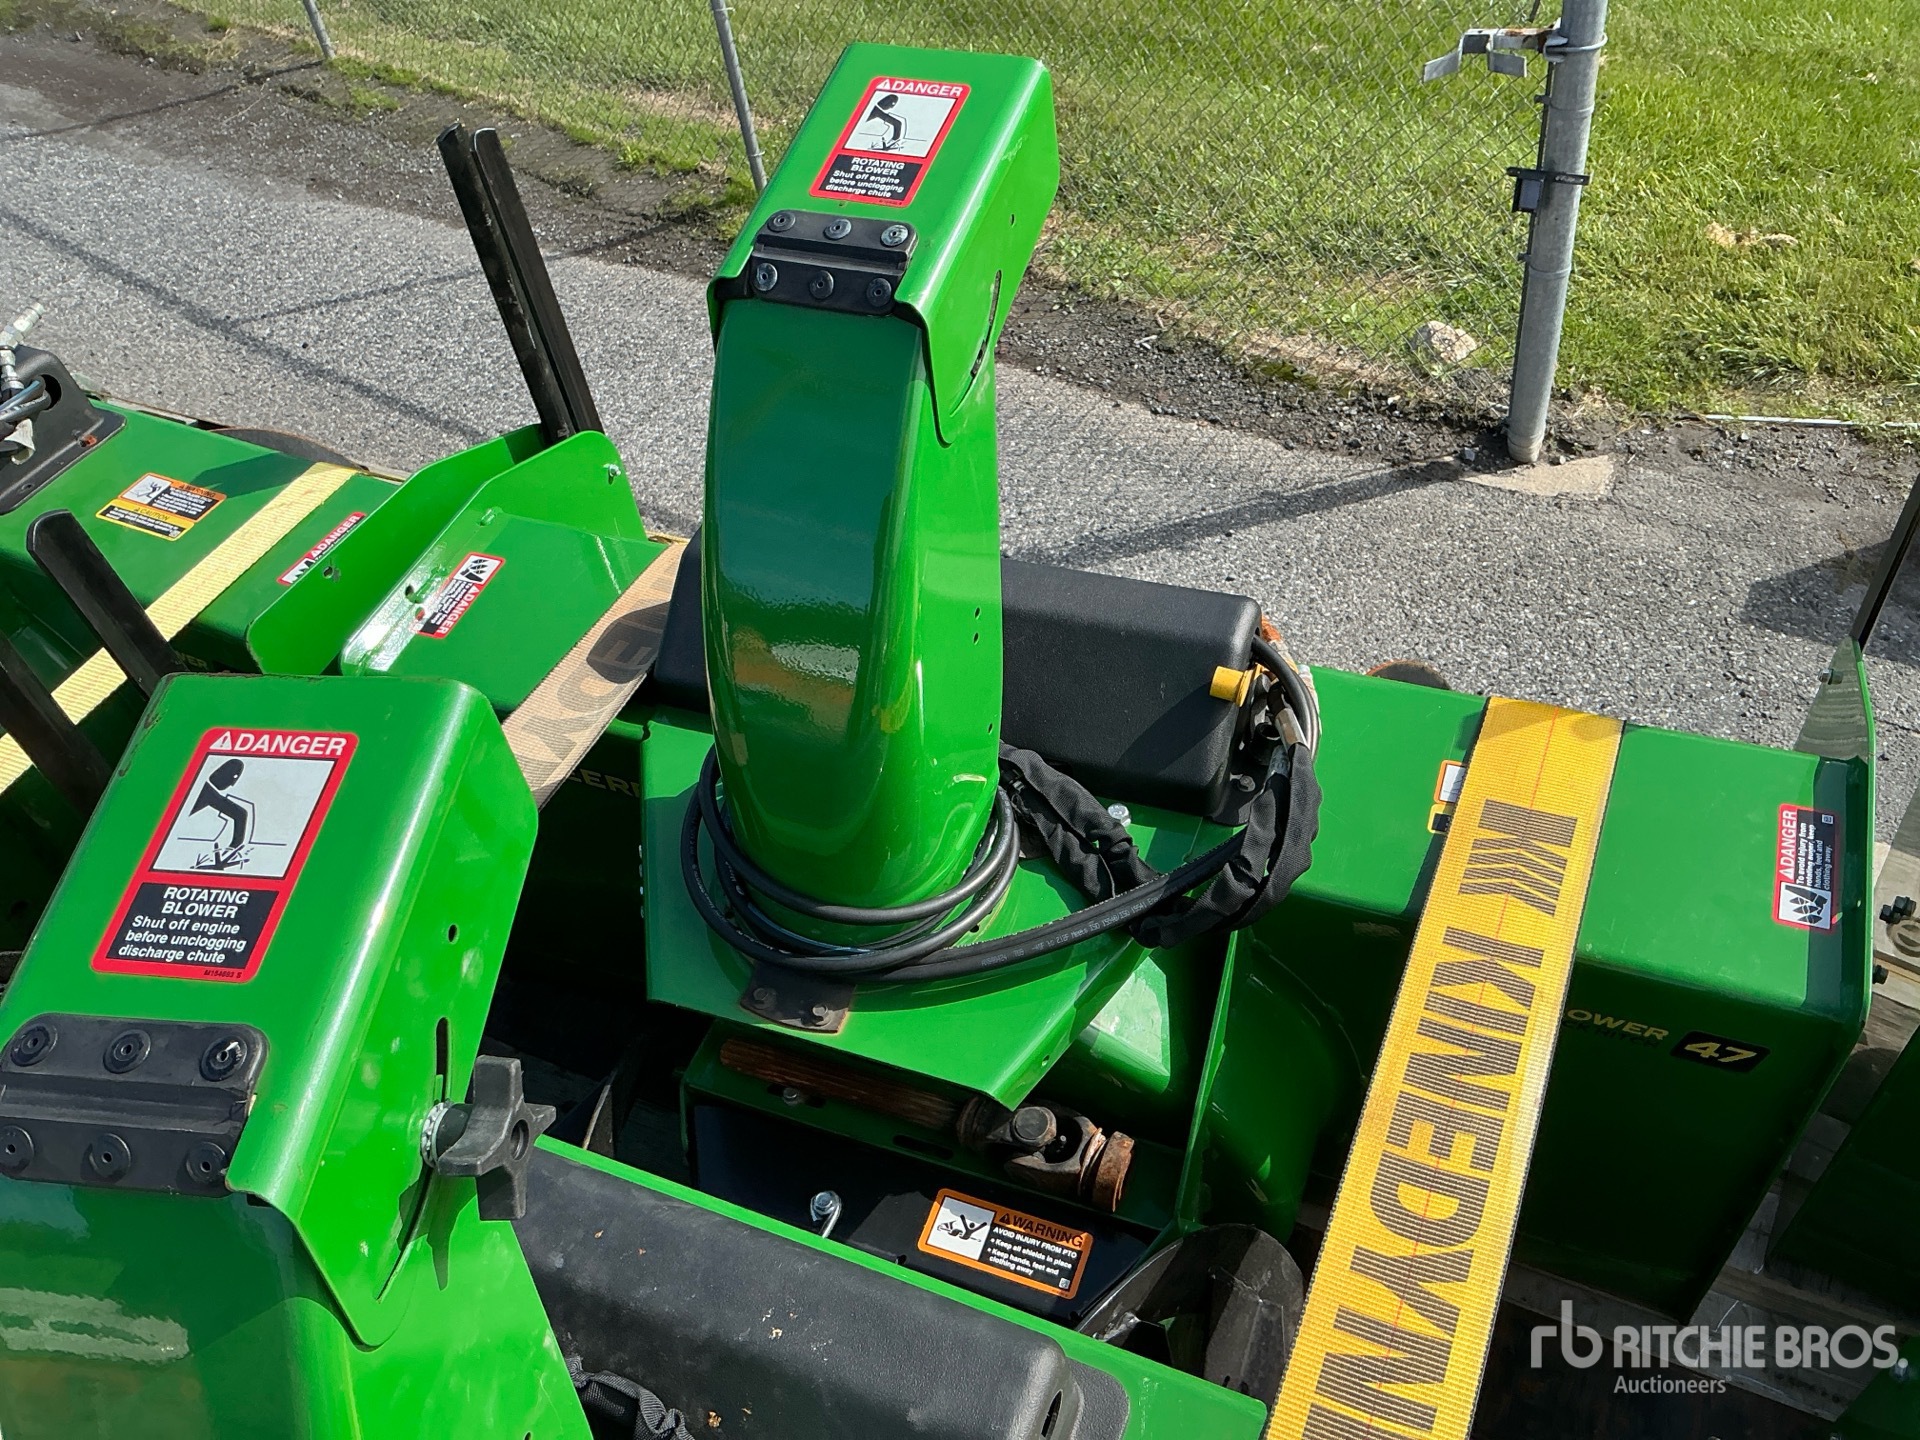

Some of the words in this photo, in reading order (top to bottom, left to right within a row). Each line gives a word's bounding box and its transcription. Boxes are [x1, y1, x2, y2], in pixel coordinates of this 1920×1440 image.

[891, 82, 963, 97] DANGER
[851, 157, 905, 170] ROTATING
[851, 165, 899, 176] BLOWER
[829, 177, 856, 187] before
[857, 181, 904, 193] unclogging
[833, 169, 854, 179] Shut
[856, 171, 869, 180] off
[870, 175, 900, 185] engine
[825, 184, 866, 196] discharge
[867, 189, 892, 198] chute
[138, 508, 170, 521] CAUTION
[317, 516, 361, 553] DANGER
[436, 591, 475, 634] DANGER
[233, 733, 347, 756] DANGER
[1779, 810, 1797, 866] DANGER
[1799, 823, 1807, 837] from
[1798, 837, 1808, 858] injury
[1796, 874, 1804, 884] To
[1806, 859, 1815, 886] rotating
[1822, 863, 1832, 891] clothing
[163, 887, 249, 904] ROTATING
[161, 901, 238, 918] BLOWER
[132, 916, 167, 930] Shut
[169, 919, 192, 931] off
[193, 922, 240, 935] engine
[1089, 922, 1100, 931] ISO
[125, 930, 168, 944] before
[170, 933, 247, 952] unclogging
[118, 945, 184, 962] discharge
[187, 950, 226, 964] chute
[1567, 1009, 1669, 1041] OWER
[1684, 1041, 1757, 1064] 47
[1012, 1215, 1083, 1248] WARNING
[993, 1226, 1014, 1237] AVOID
[1015, 1231, 1042, 1248] INJURY
[1042, 1240, 1062, 1252] FROM
[1062, 1248, 1077, 1258] PTO
[992, 1248, 1009, 1261] Keep
[1009, 1252, 1032, 1267] hands,
[1032, 1261, 1046, 1271] feet
[1046, 1265, 1059, 1276] and
[995, 1239, 1014, 1251] Keep
[1013, 1244, 1022, 1253] all
[1021, 1246, 1046, 1260] shields
[1053, 1257, 1072, 1269] place
[990, 1256, 1015, 1270] clothing
[1016, 1264, 1034, 1276] away
